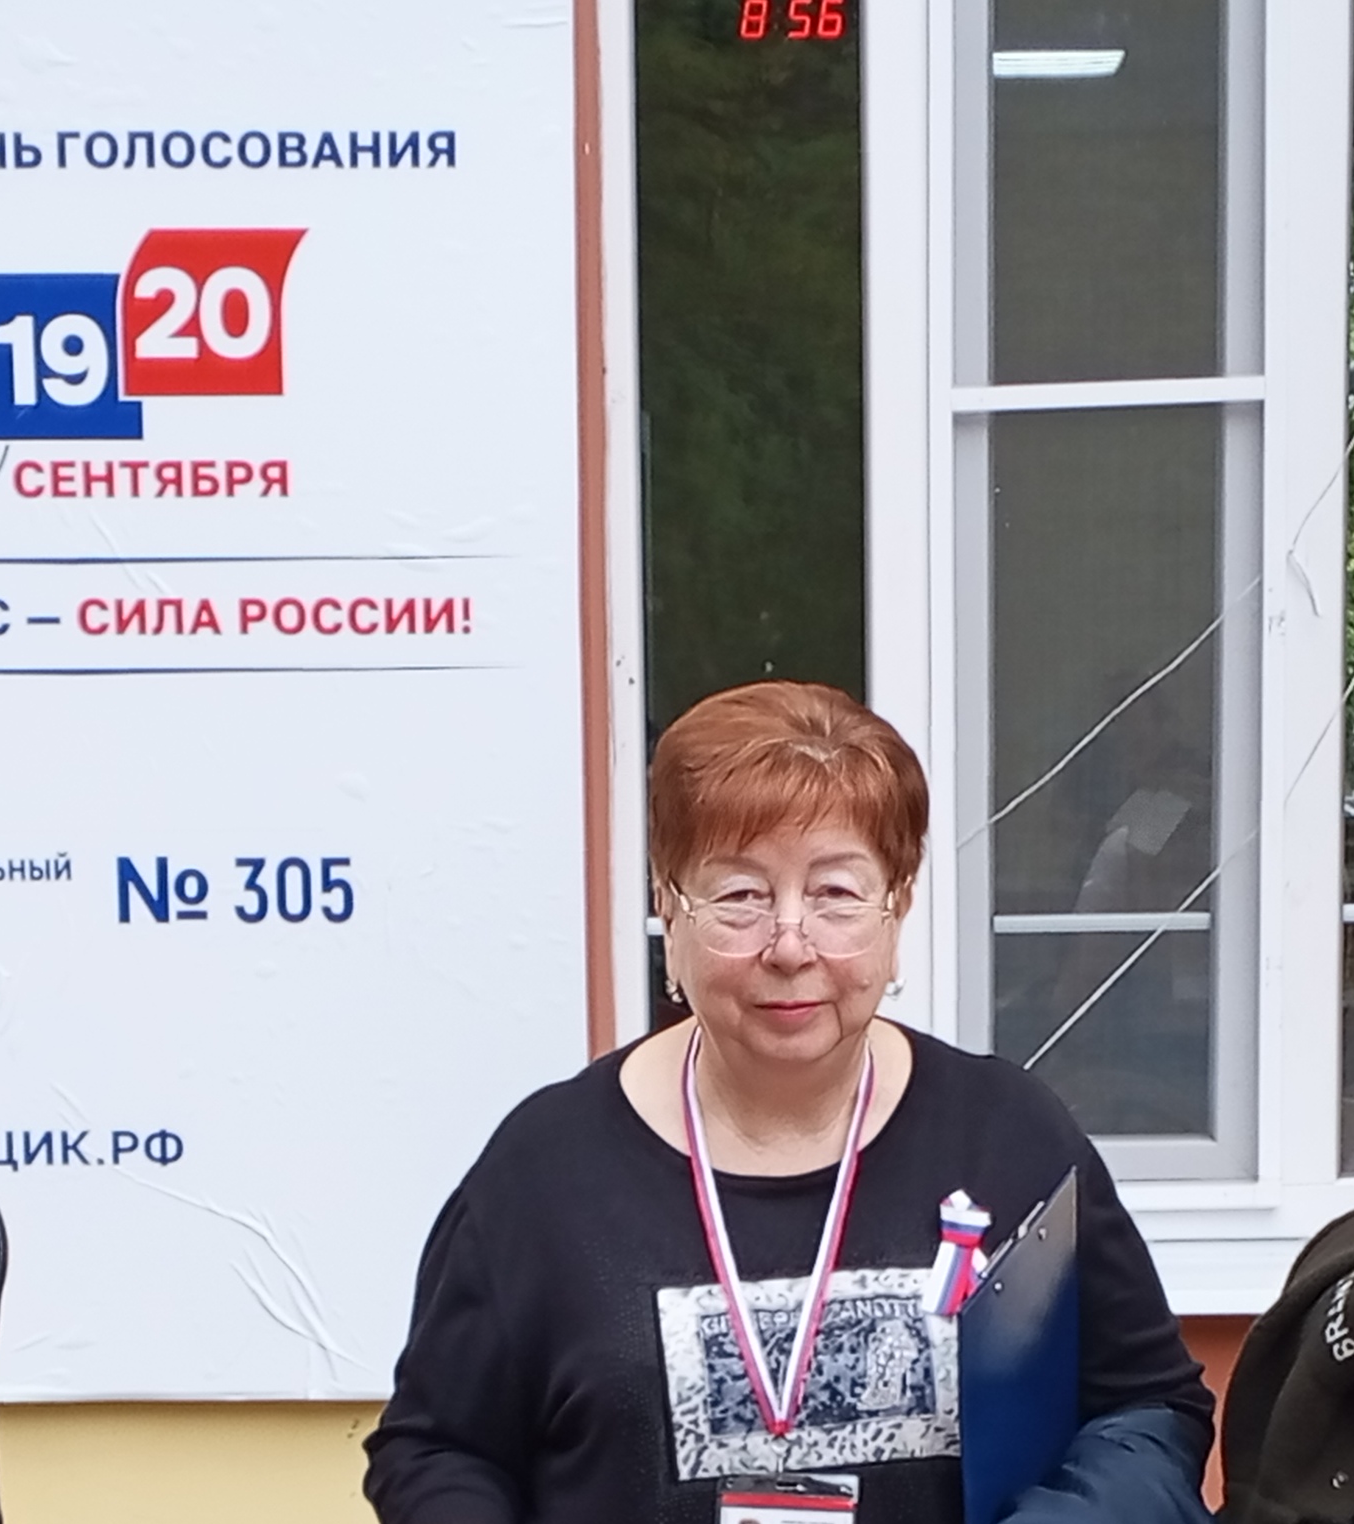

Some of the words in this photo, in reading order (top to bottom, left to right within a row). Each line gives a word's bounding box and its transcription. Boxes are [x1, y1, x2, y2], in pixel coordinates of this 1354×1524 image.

[56, 130, 456, 170] ГОЛОСОВАНИЯ
[133, 266, 272, 359] 20
[13, 459, 289, 499] СЕНТЯБРЯ
[77, 598, 222, 636] СИЛА
[238, 597, 472, 636] РОССИИ!
[234, 856, 355, 925] 305
